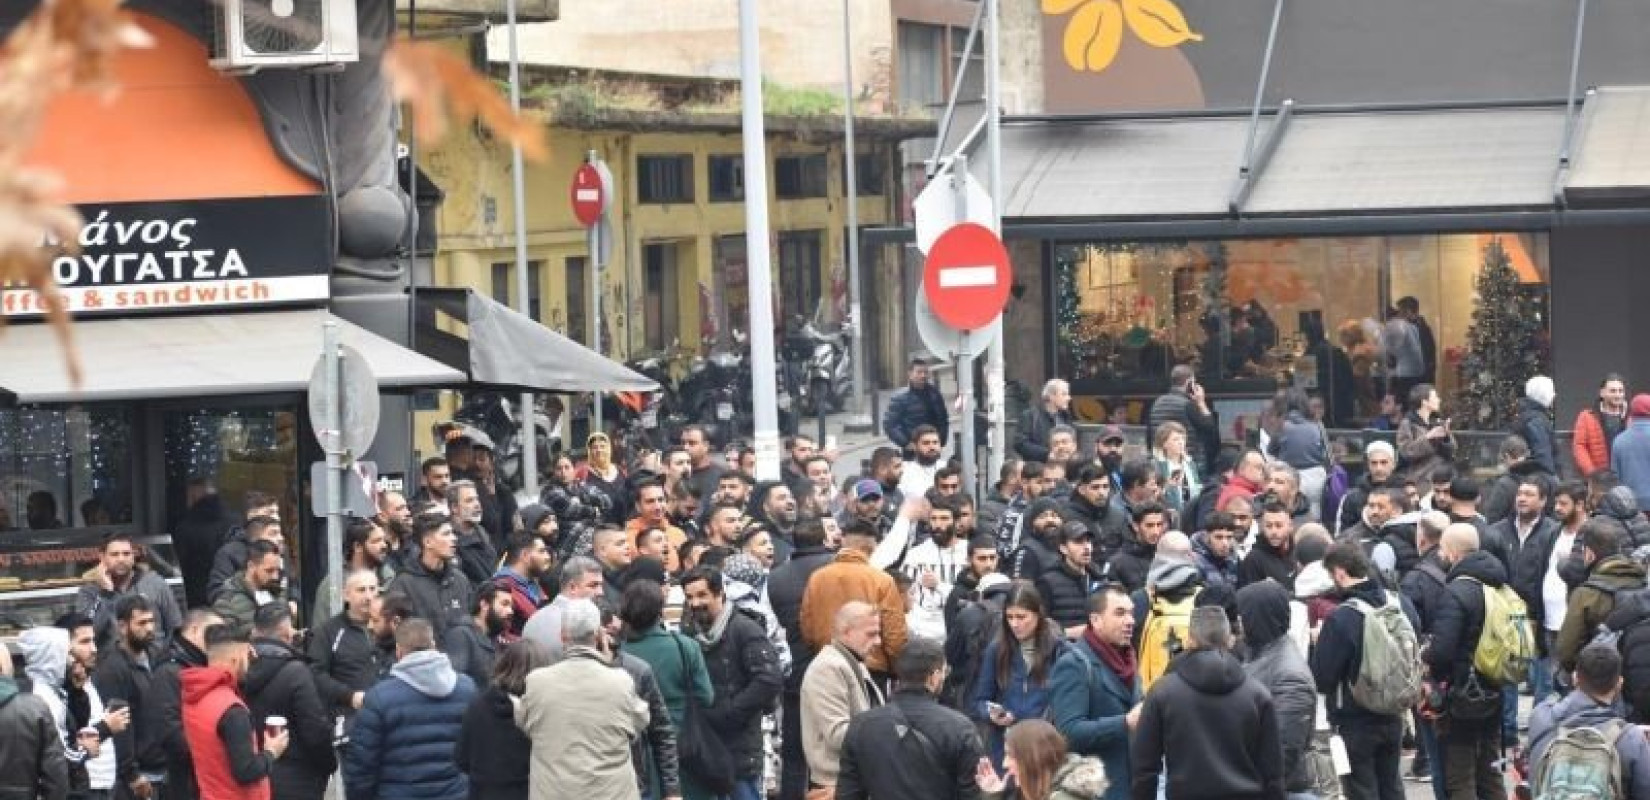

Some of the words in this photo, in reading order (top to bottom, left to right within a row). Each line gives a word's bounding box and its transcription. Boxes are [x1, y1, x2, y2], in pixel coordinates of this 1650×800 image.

[34, 209, 197, 249] άνος
[4, 248, 249, 287] ΟΥΓΑΤΣΑ
[83, 289, 104, 308] &
[115, 281, 270, 306] sandwich
